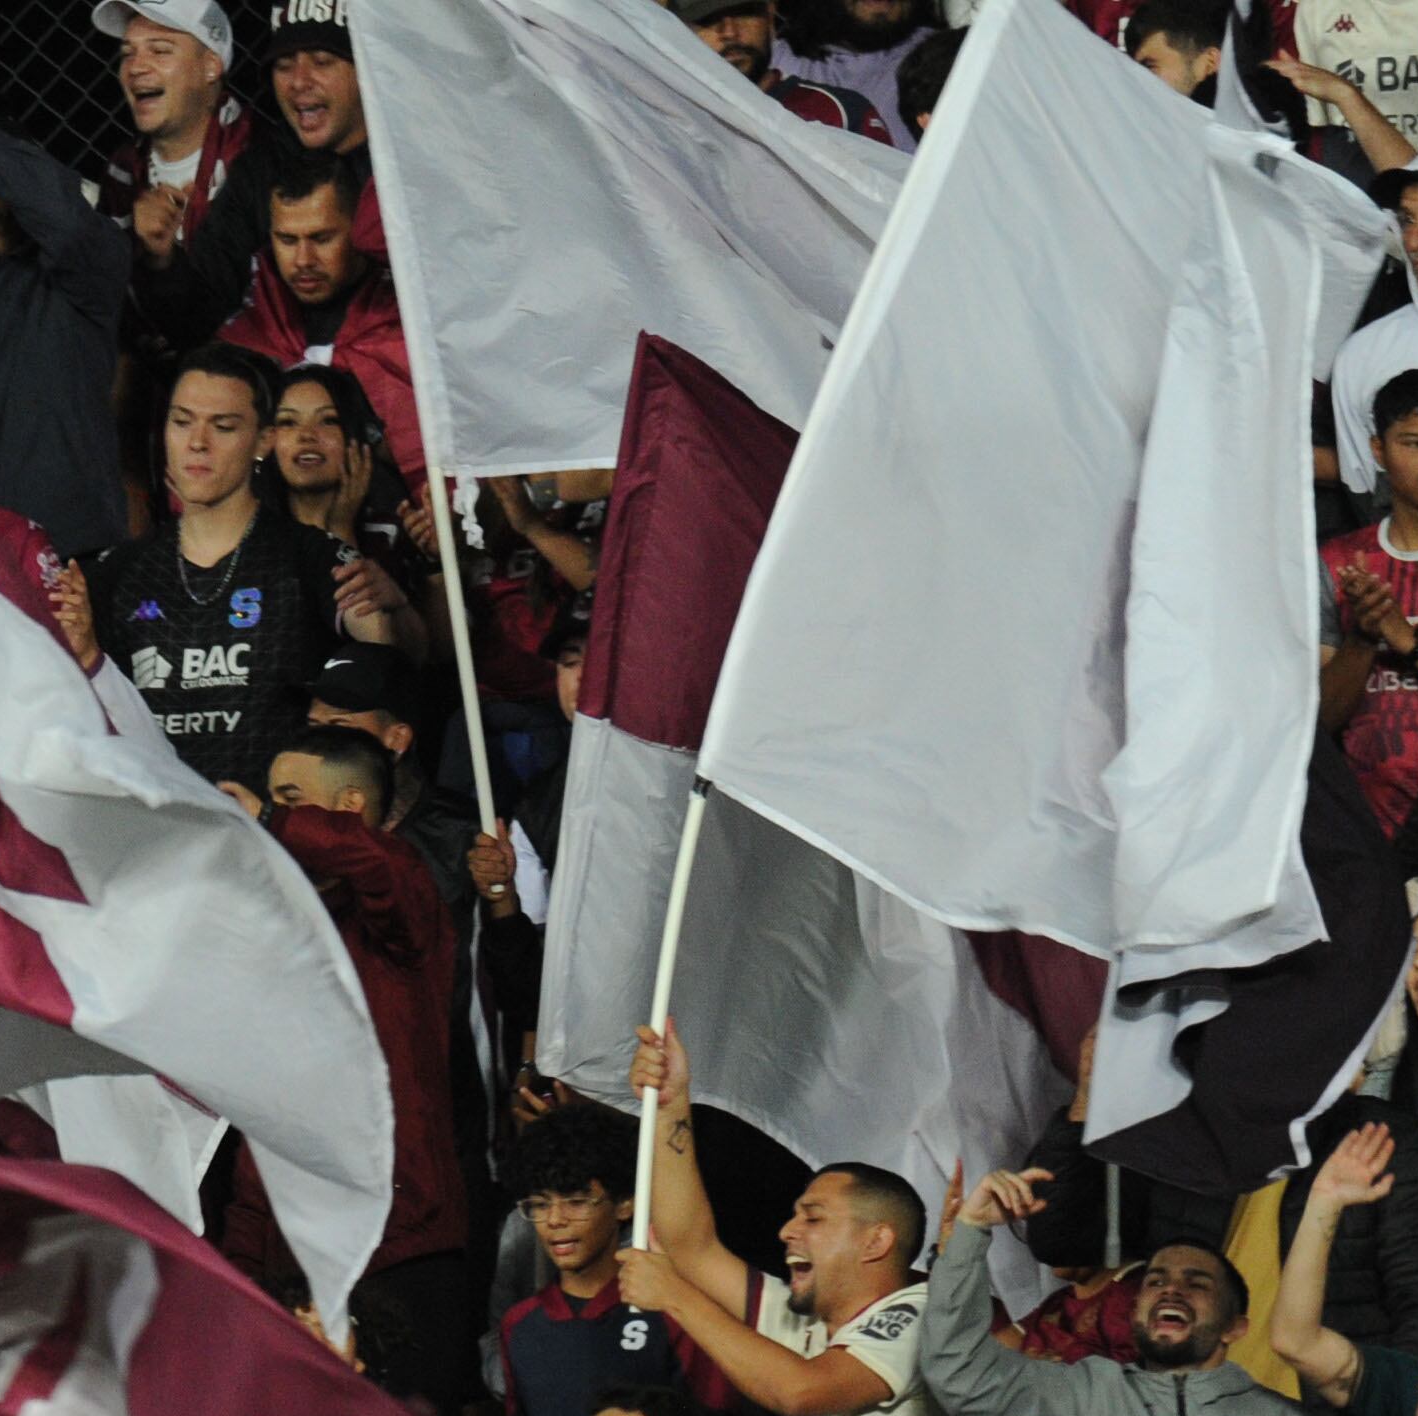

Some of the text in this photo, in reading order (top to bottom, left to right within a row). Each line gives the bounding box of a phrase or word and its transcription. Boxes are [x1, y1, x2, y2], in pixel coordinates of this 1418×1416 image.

[229, 588, 261, 628] S
[181, 643, 251, 680] BAC
[619, 1319, 649, 1351] S
